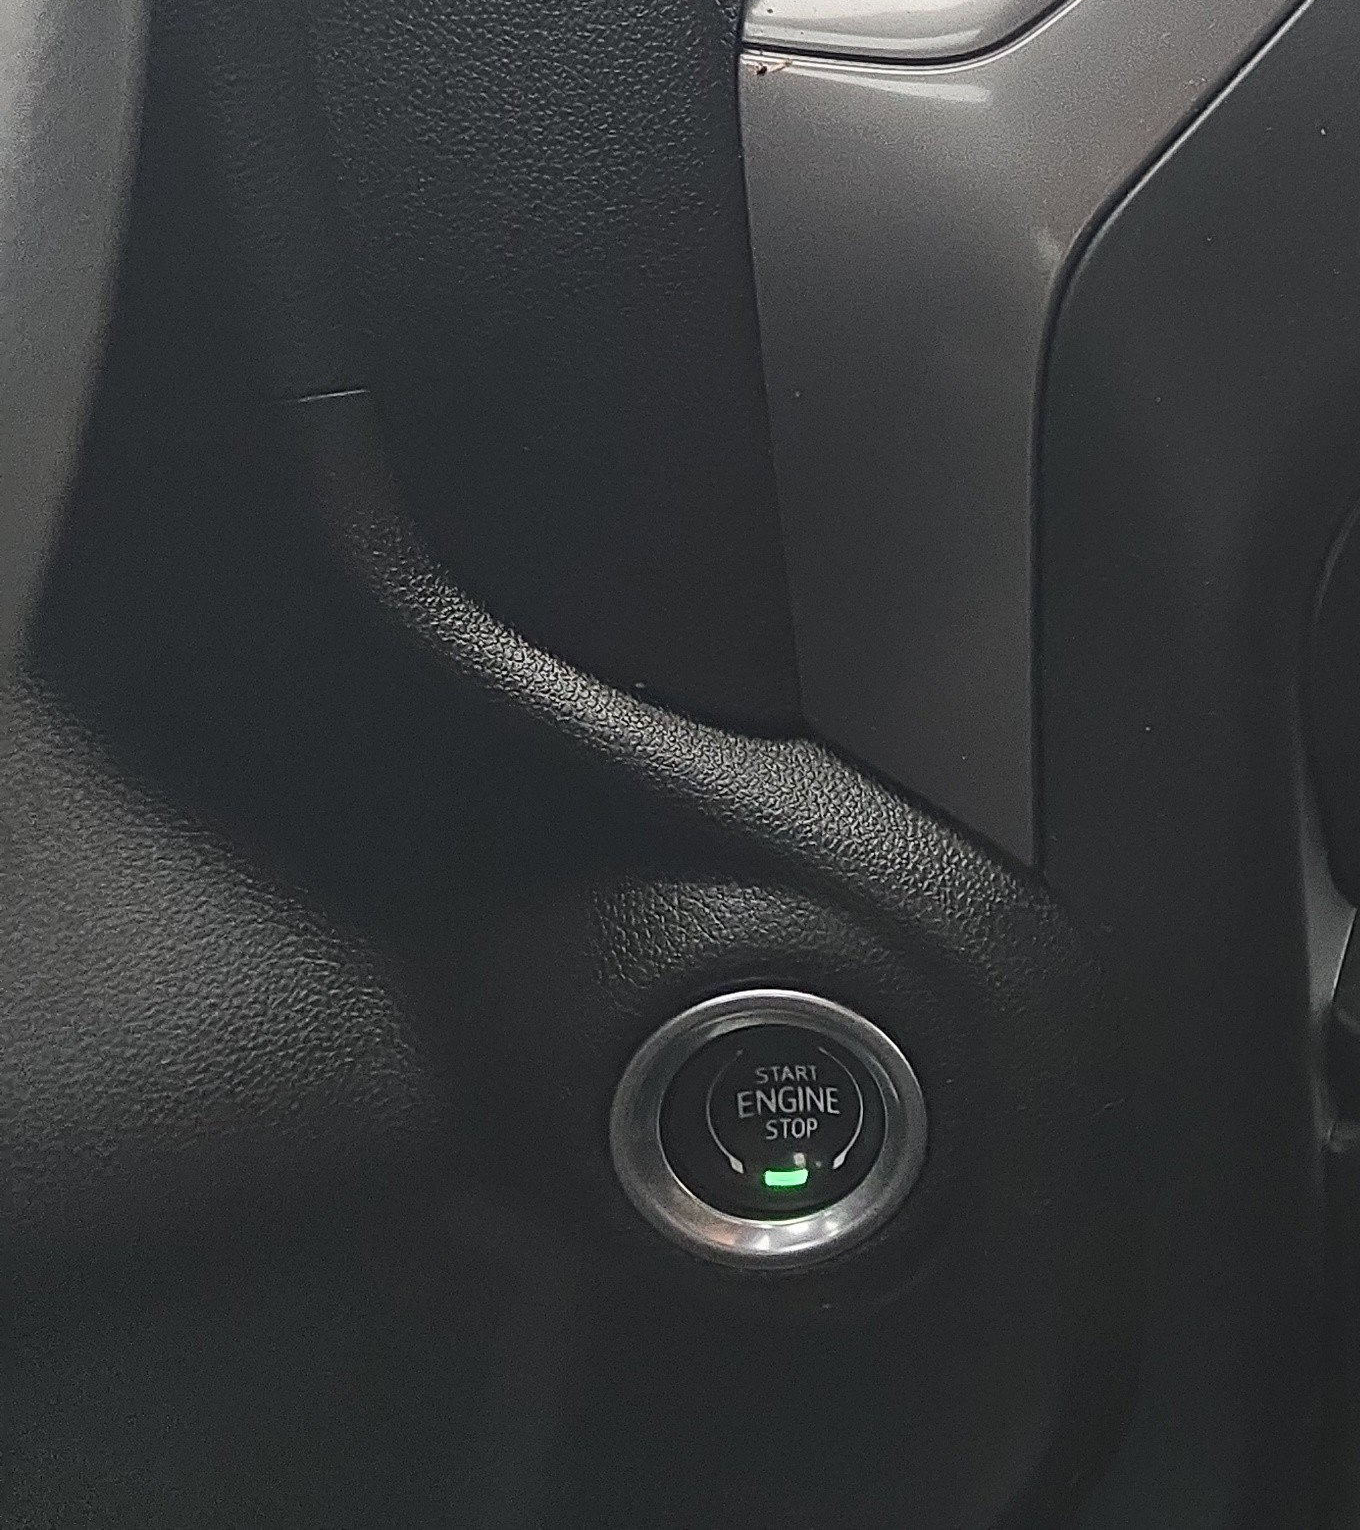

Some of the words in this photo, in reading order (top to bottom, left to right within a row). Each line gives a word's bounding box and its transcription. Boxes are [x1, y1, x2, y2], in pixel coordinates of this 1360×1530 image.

[754, 1064, 818, 1084] START
[737, 1086, 841, 1119] ENGINE
[764, 1118, 819, 1140] STOP
